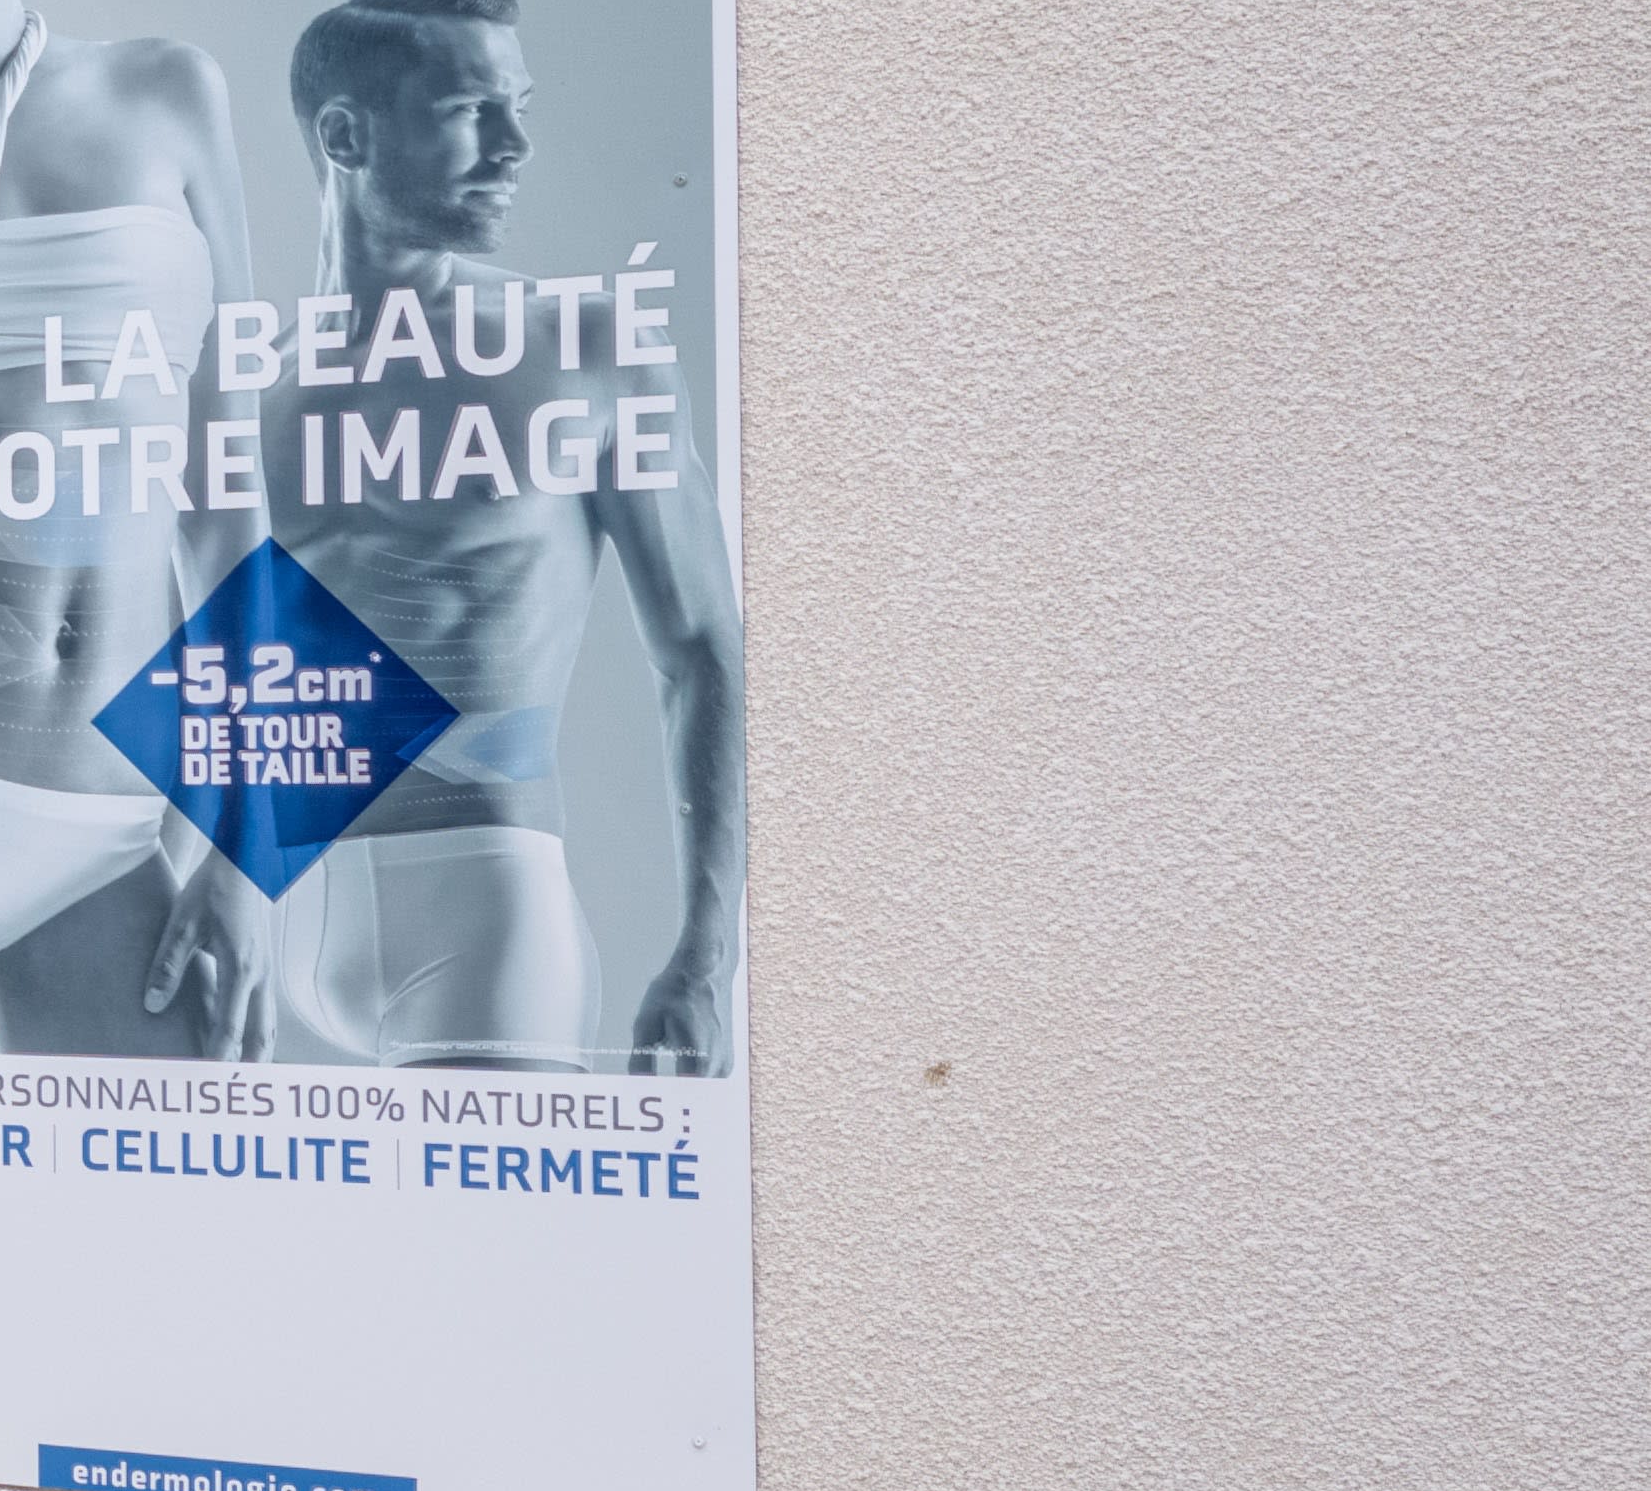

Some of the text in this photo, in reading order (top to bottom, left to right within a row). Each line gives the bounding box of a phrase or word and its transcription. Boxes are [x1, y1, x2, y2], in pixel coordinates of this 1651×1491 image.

[43, 241, 678, 404] LA BEAUTÉ
[300, 394, 679, 506] IMAGE
[181, 713, 345, 750] DE TOUR
[181, 749, 372, 785] DE TAILLE
[288, 1084, 405, 1122] 100%
[422, 1088, 665, 1133] NATURELS
[81, 1127, 371, 1185] CELLULITE
[423, 1139, 700, 1200] FERMETÉ
